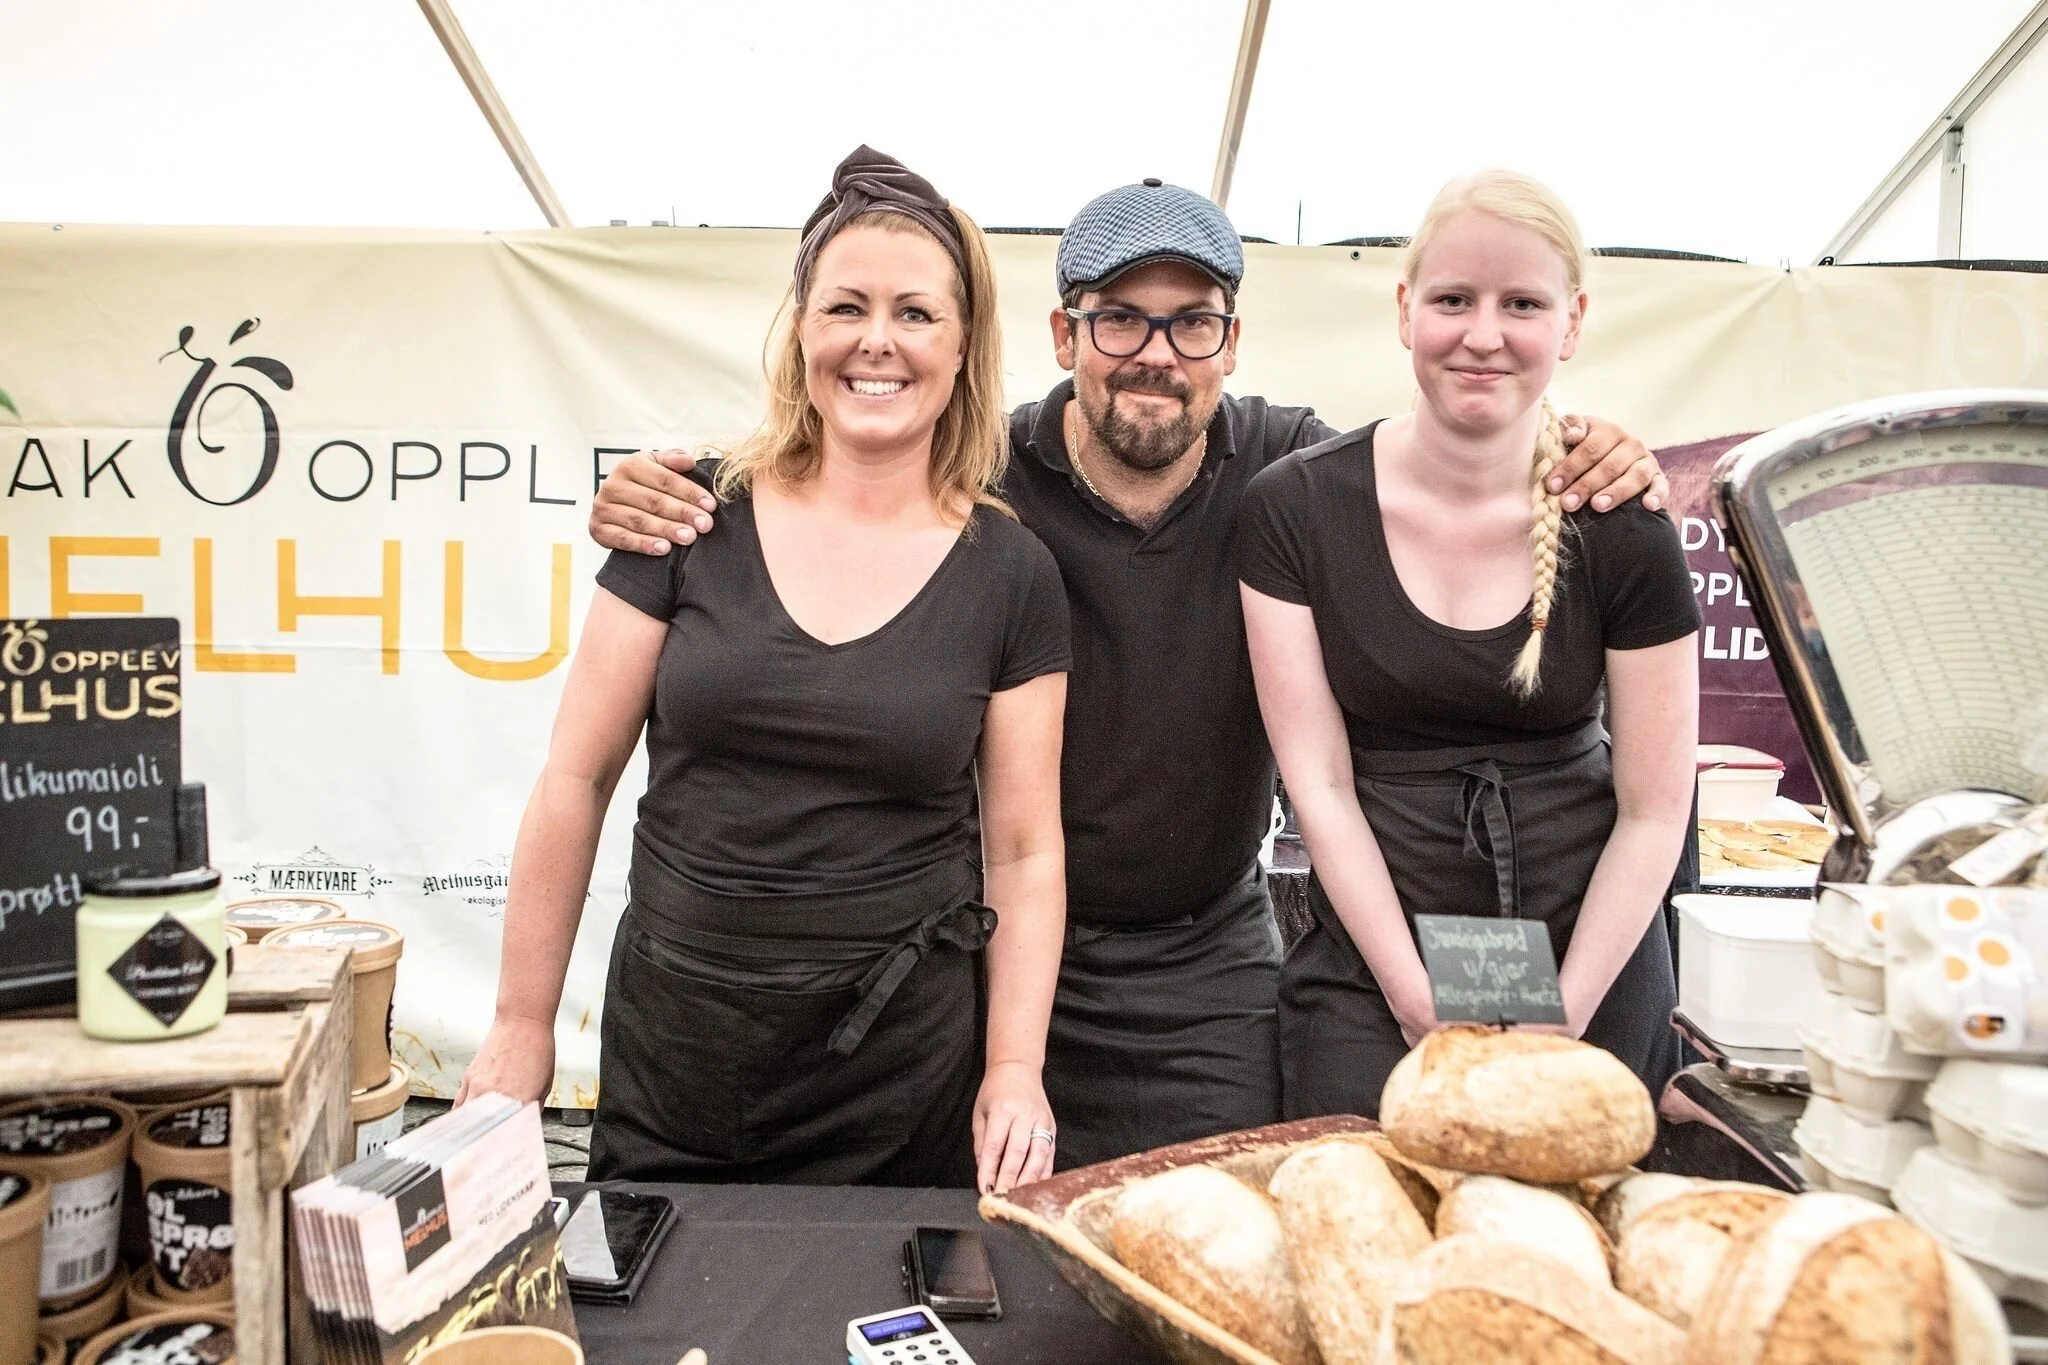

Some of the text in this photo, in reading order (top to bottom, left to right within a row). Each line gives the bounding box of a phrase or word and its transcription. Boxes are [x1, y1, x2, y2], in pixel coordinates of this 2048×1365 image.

[8, 438, 135, 499] AK
[309, 440, 660, 505] OPPLE
[0, 534, 573, 682] ELHU
[51, 650, 181, 674] OPPLEV
[0, 674, 182, 725] LHUS
[65, 805, 149, 853] 99,-
[268, 868, 358, 892] MÆRKEVARE
